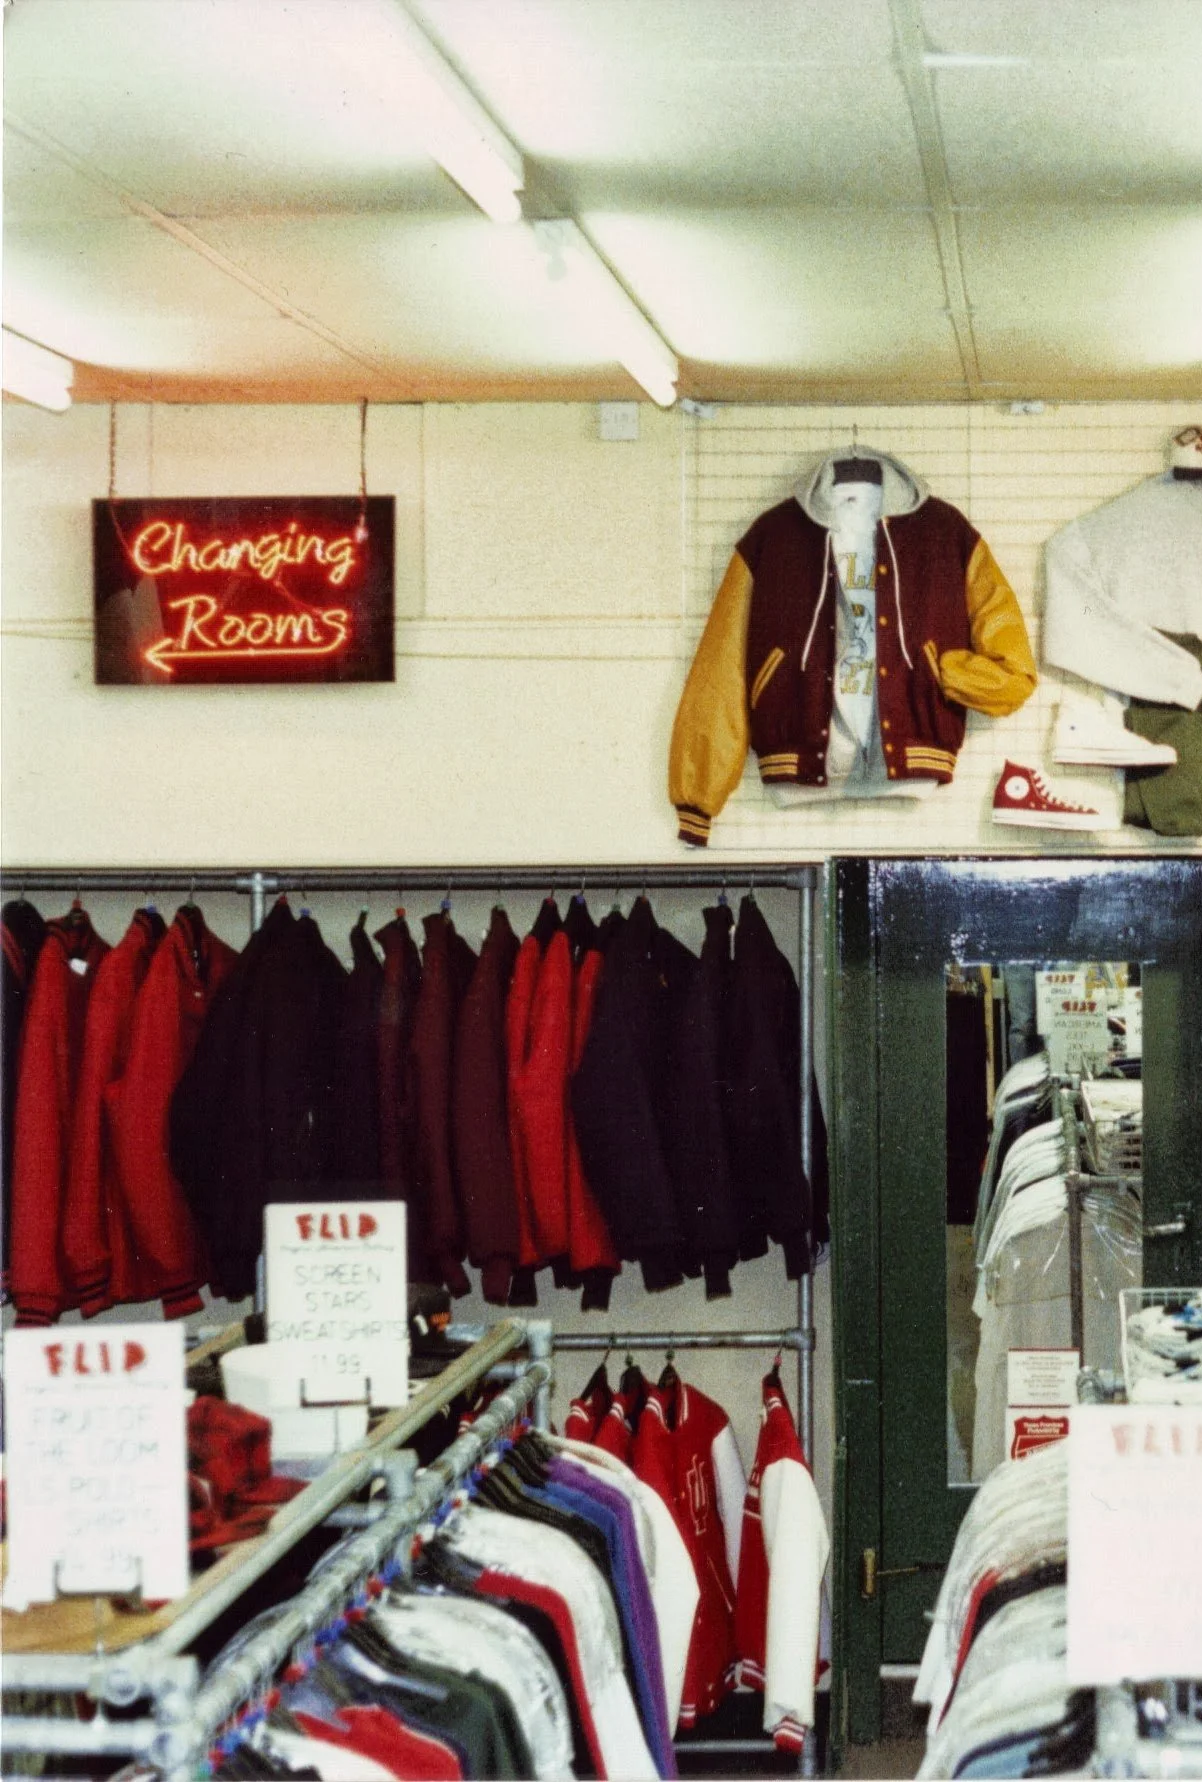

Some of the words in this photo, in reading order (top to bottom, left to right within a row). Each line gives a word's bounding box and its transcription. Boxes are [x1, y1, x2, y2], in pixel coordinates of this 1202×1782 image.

[132, 520, 356, 585] Changing
[168, 594, 348, 650] Rooms
[295, 1213, 378, 1240] FLIP
[294, 1263, 381, 1286] SCREEN
[304, 1291, 372, 1312] STARS
[41, 1340, 147, 1376] FLIP
